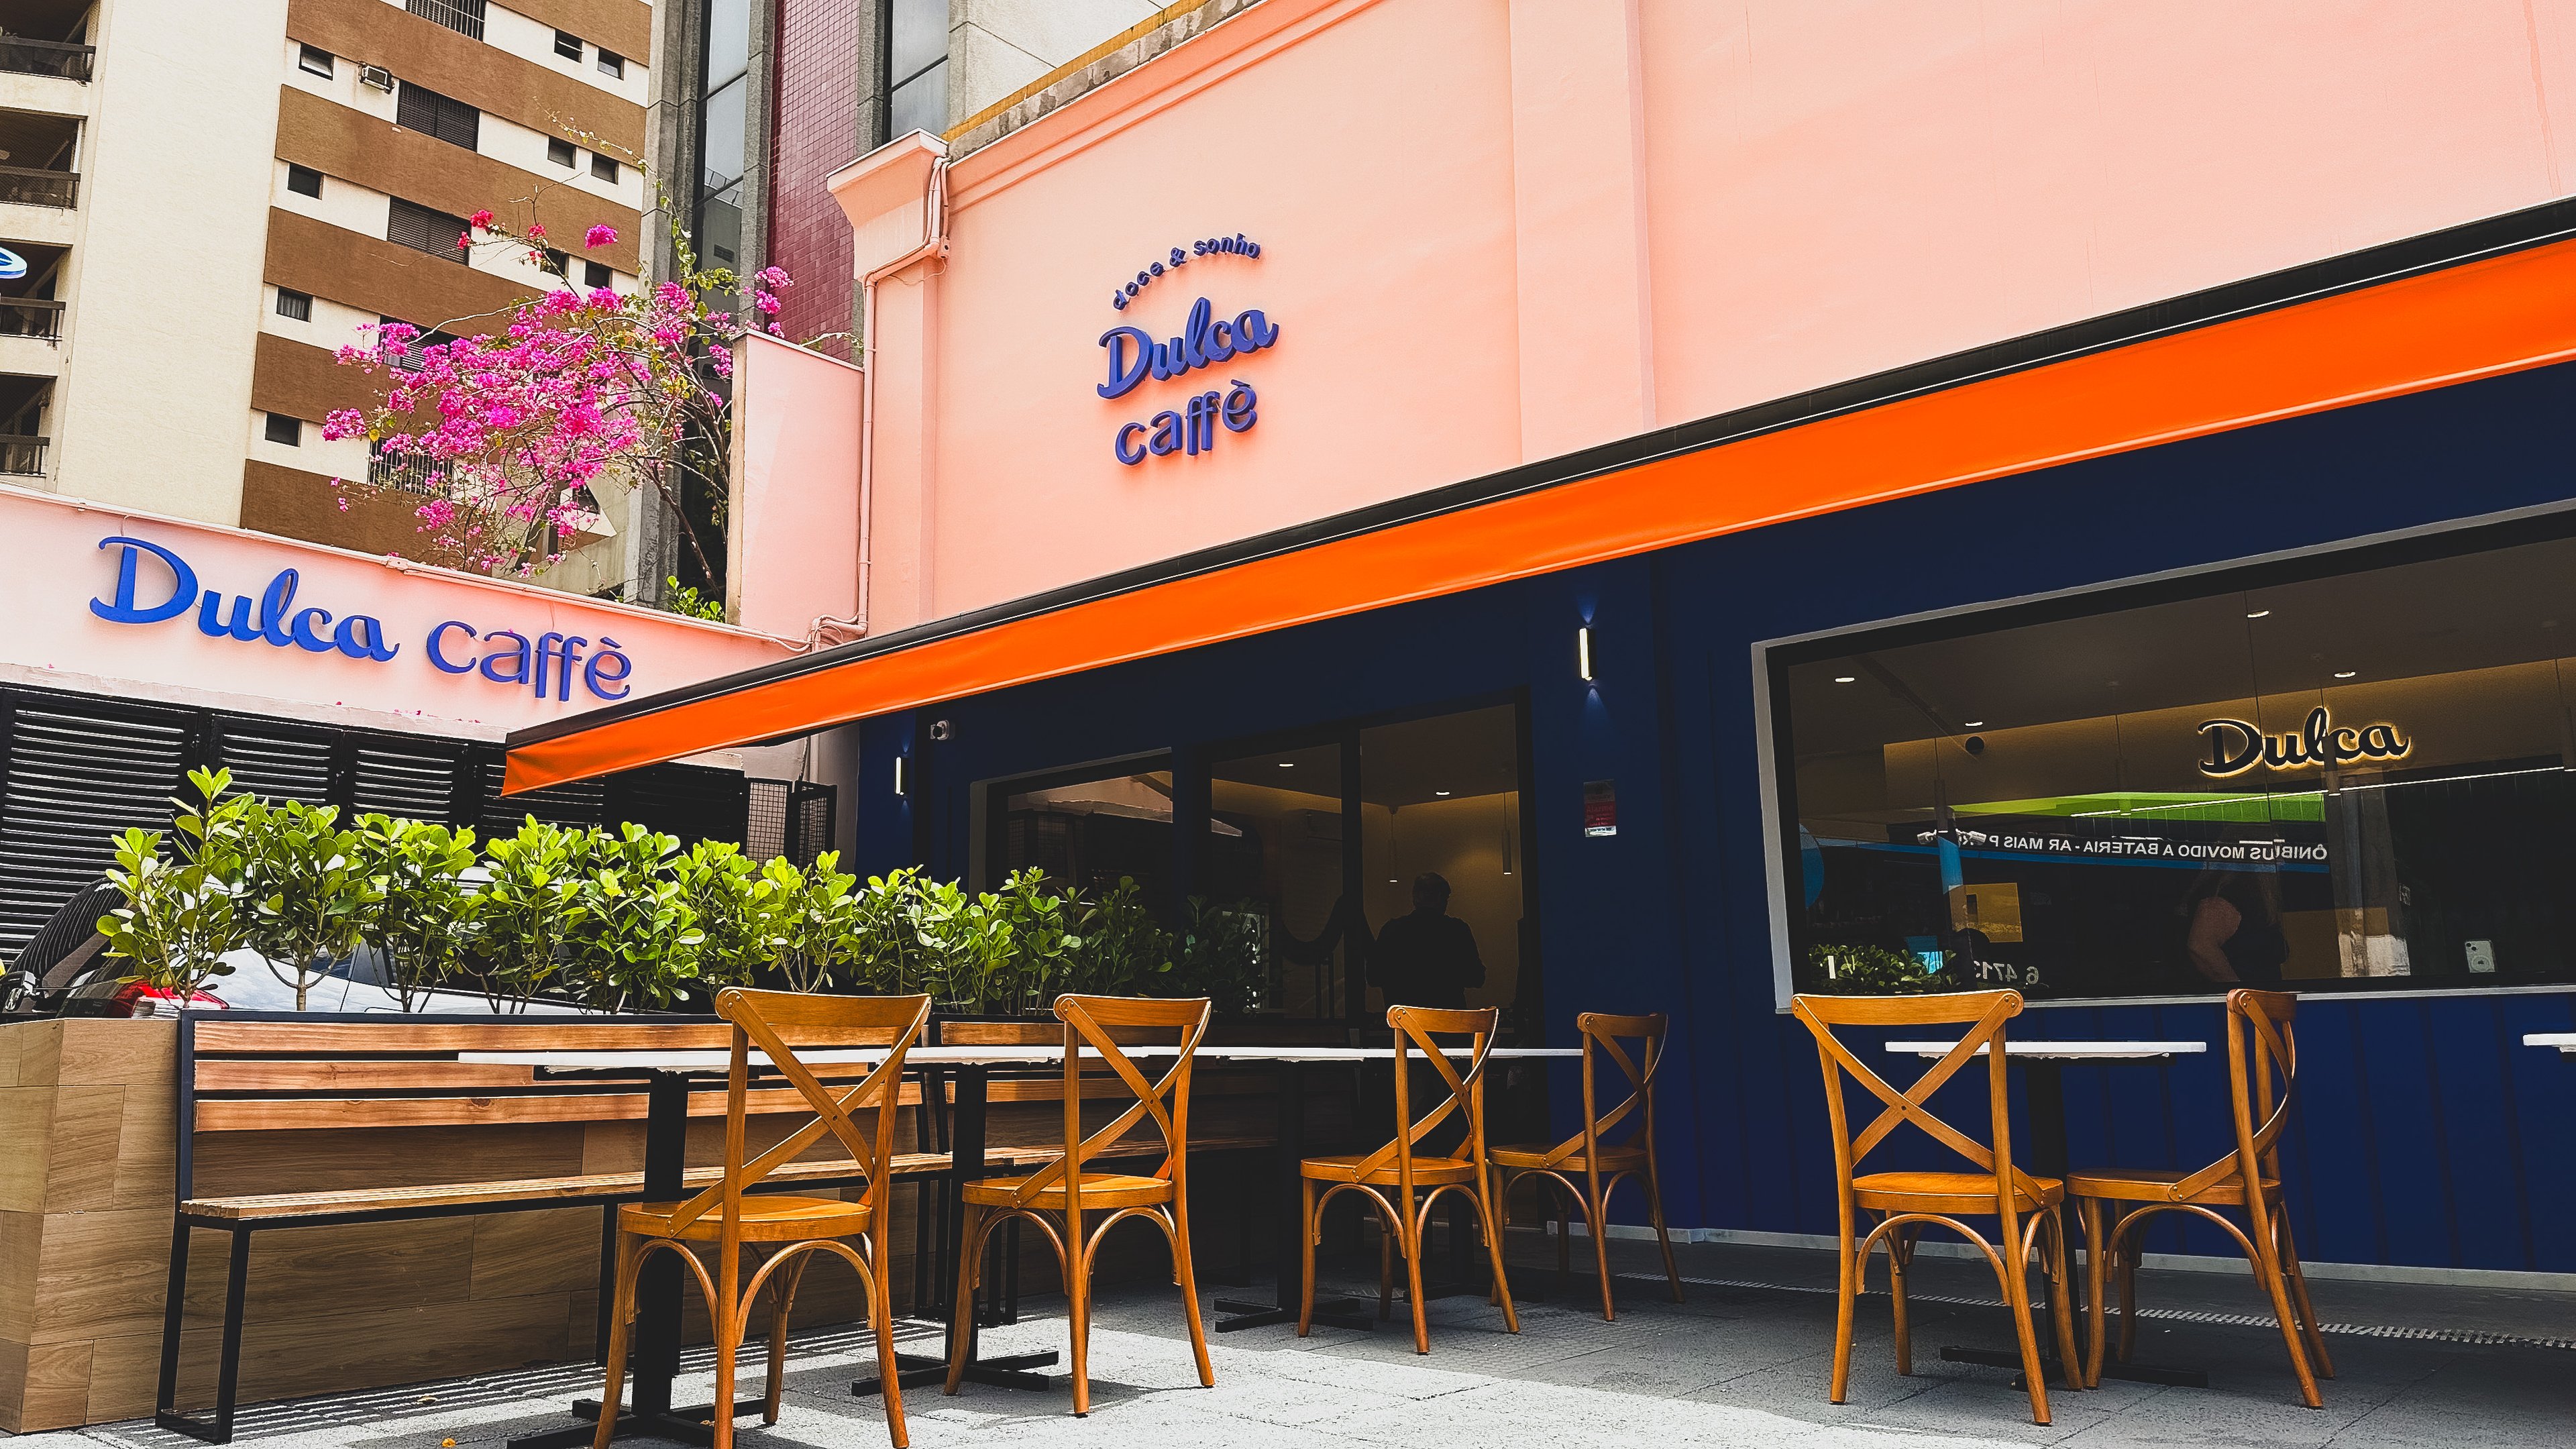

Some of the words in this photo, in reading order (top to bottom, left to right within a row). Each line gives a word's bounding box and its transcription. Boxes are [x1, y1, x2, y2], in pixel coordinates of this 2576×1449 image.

[1112, 261, 1164, 311] doce
[1169, 247, 1187, 268] &
[1193, 233, 1261, 259] sonho
[1096, 297, 1279, 400] Dulca
[1115, 378, 1258, 466] caffè
[89, 535, 400, 663] Dulca
[426, 620, 632, 702] caffè
[2197, 706, 2412, 778] Dulca
